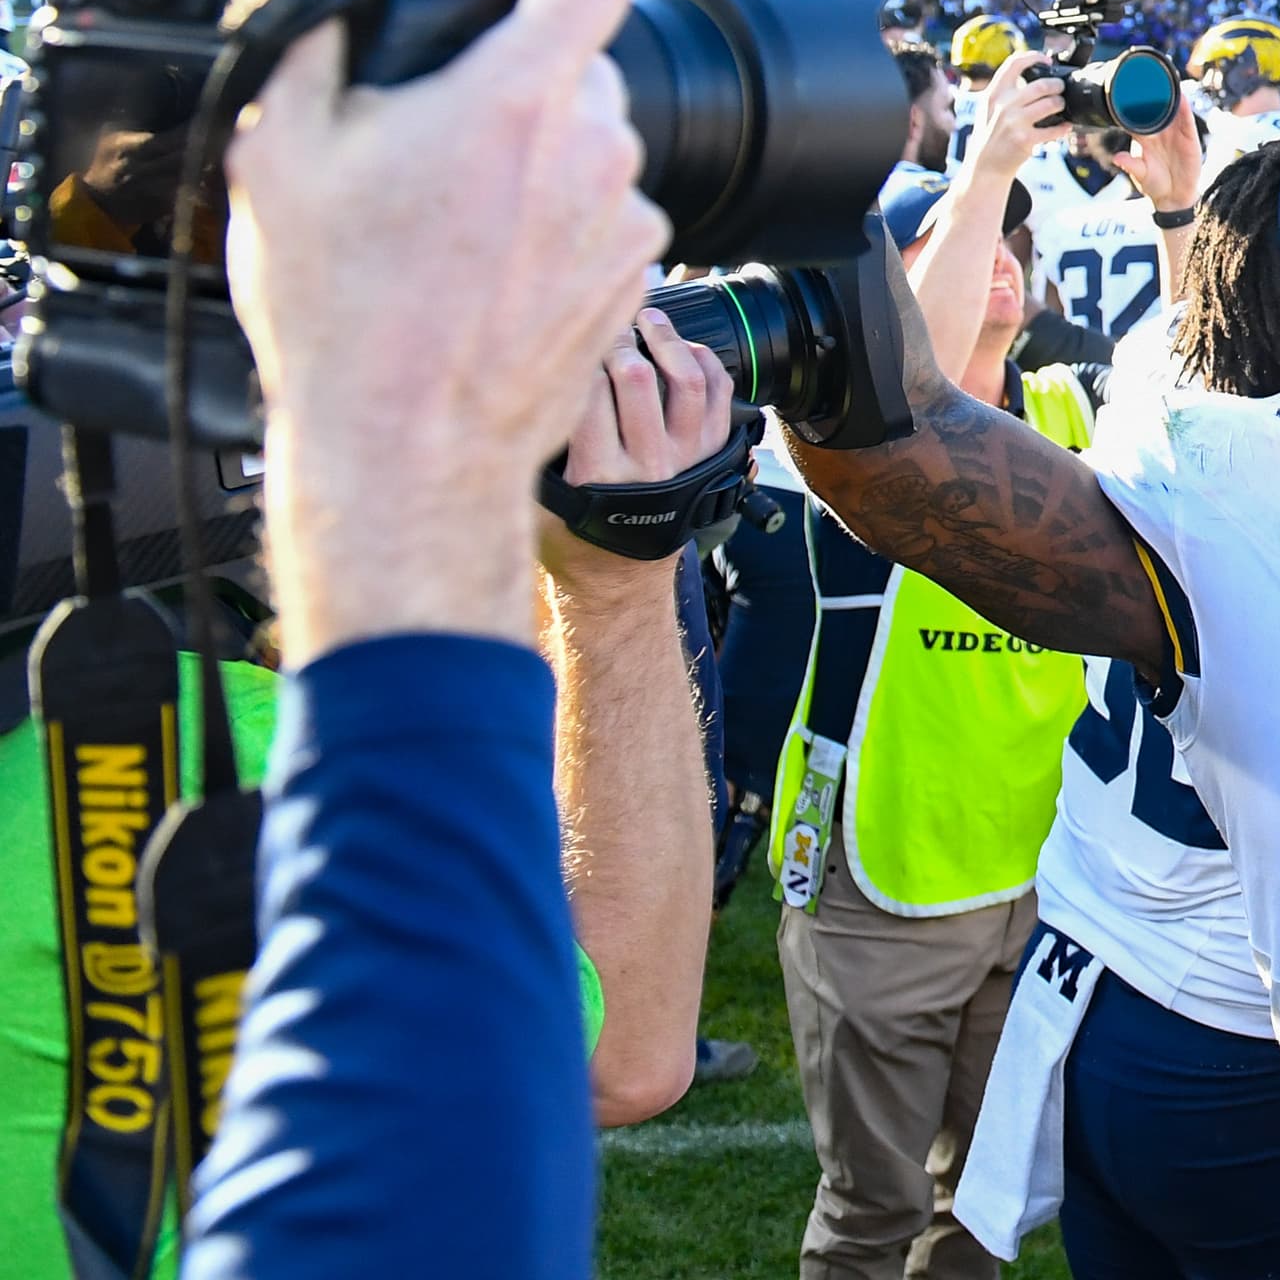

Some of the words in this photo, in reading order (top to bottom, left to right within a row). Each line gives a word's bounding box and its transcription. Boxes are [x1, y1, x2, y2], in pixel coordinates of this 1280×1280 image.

[1059, 244, 1161, 343] 32
[607, 510, 677, 525] Canon
[74, 743, 150, 928] Nikon
[1038, 934, 1095, 1004] M
[82, 940, 163, 1134] D750
